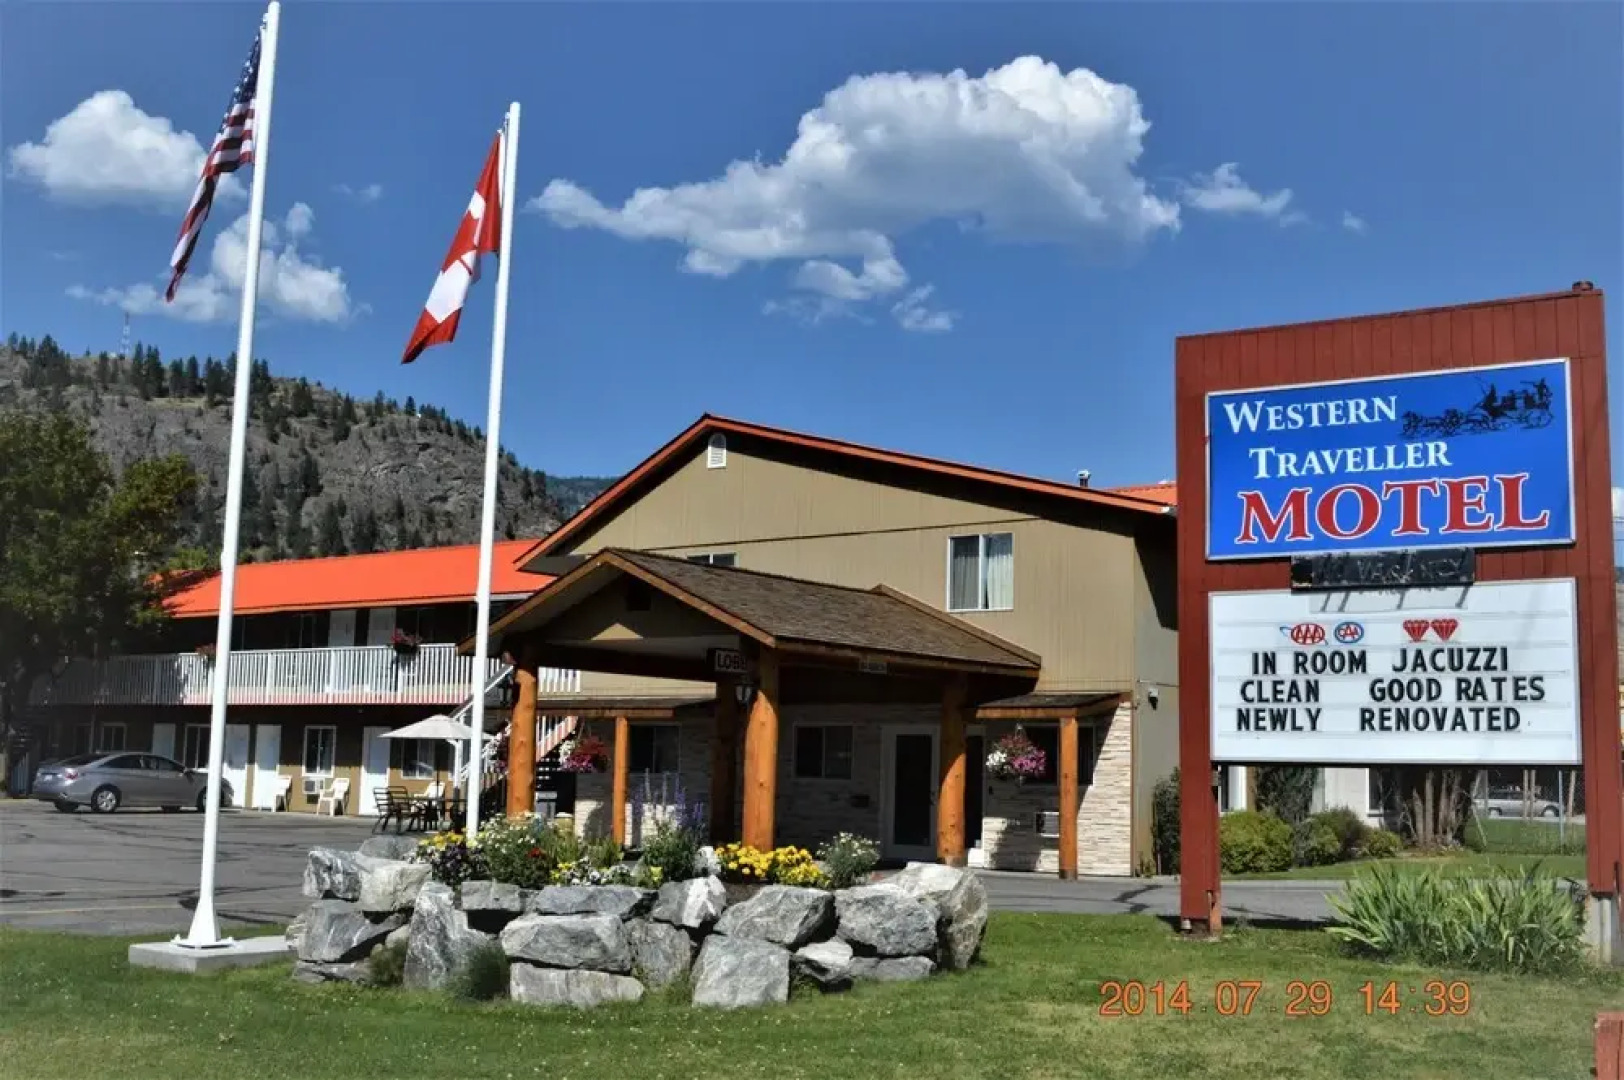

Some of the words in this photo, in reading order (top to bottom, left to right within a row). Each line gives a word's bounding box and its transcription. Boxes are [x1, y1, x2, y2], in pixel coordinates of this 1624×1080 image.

[1223, 395, 1398, 434] WESTERN
[1249, 441, 1453, 479] TRAVELLER
[1235, 473, 1550, 544] MOTEL
[1291, 623, 1325, 645] AAA
[1252, 652, 1277, 675] IN
[1294, 650, 1367, 675] ROOM
[1392, 647, 1509, 673] JACUZZI
[1240, 678, 1320, 703] CLEAN
[1370, 677, 1442, 702] GOOD
[1456, 675, 1546, 702] RATES
[1236, 708, 1322, 732] NEWLY
[1360, 706, 1521, 732] RENOVATED
